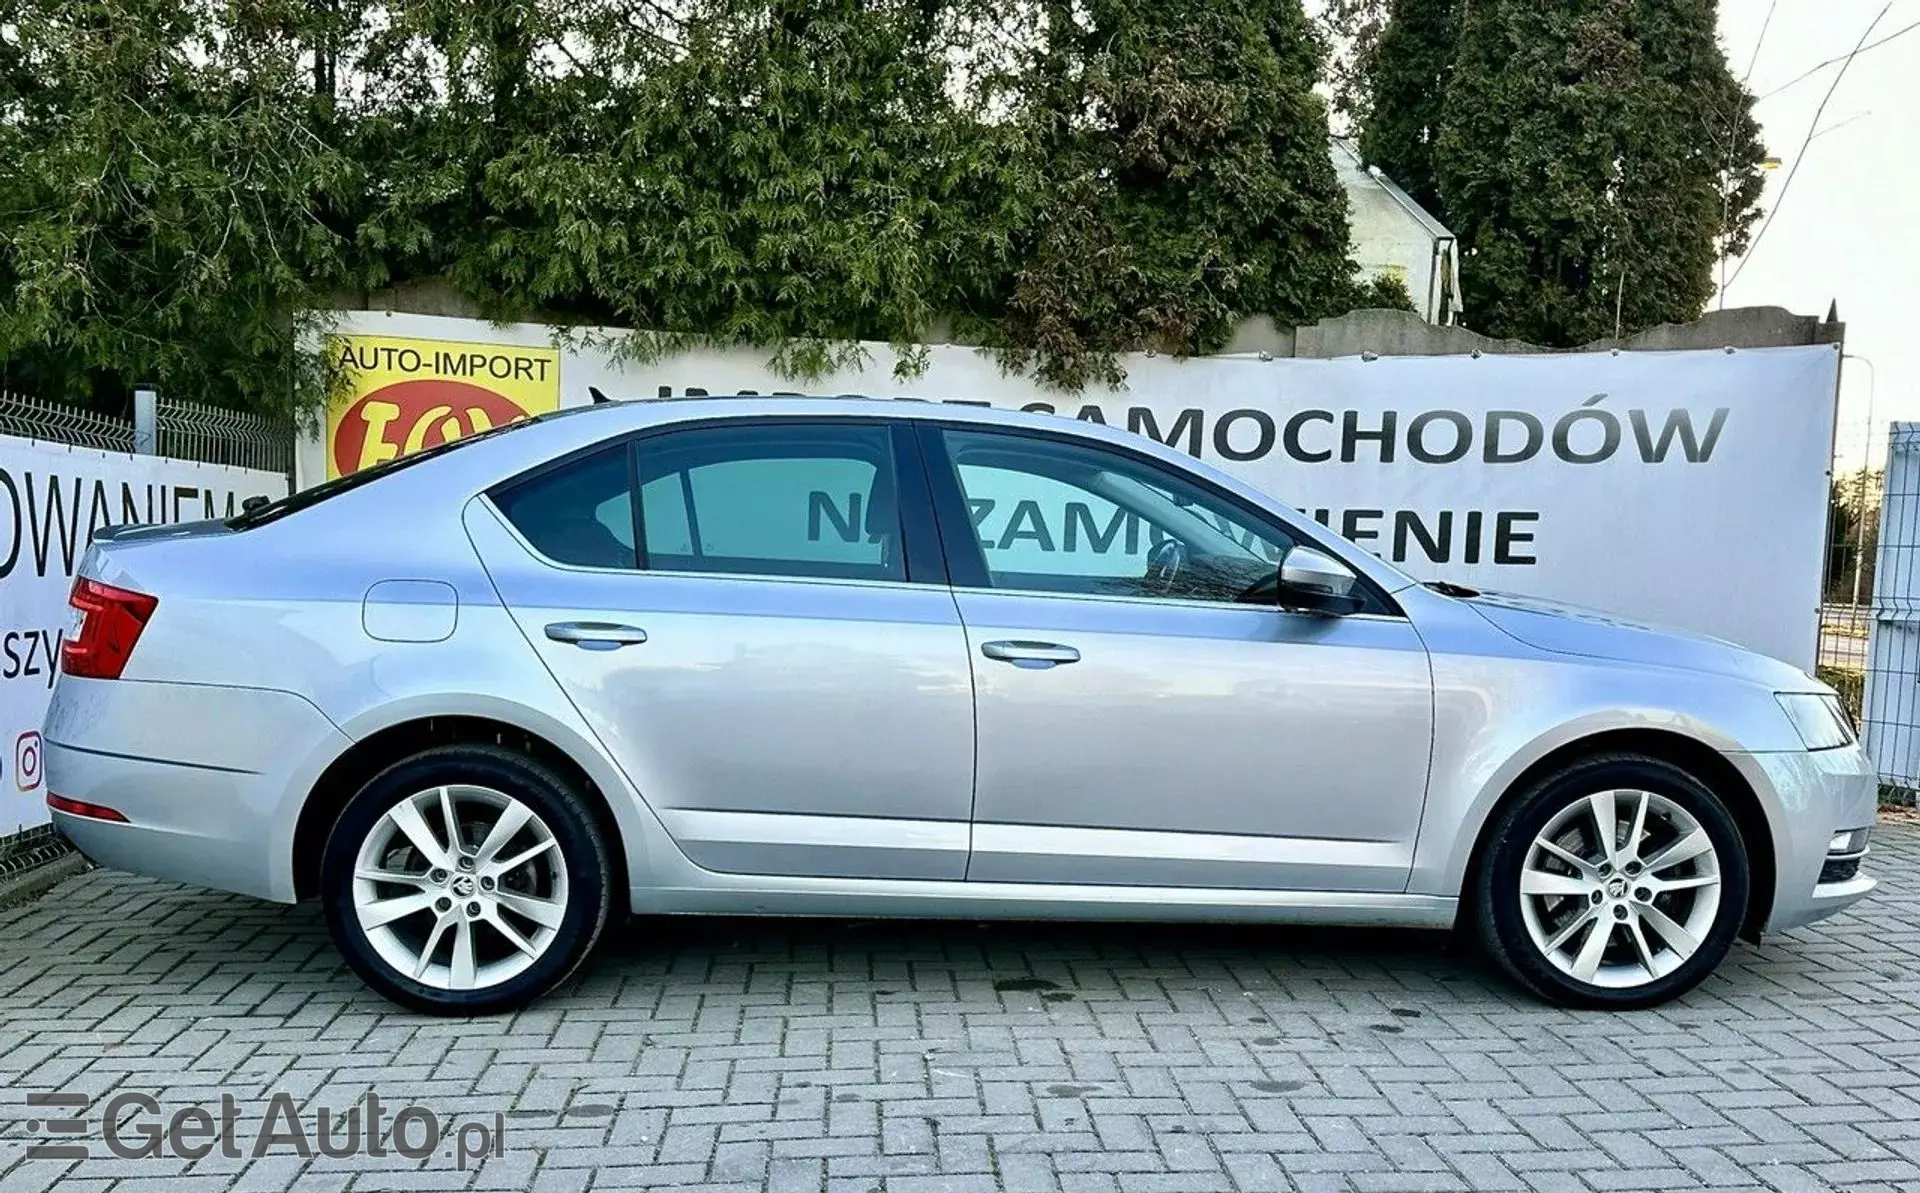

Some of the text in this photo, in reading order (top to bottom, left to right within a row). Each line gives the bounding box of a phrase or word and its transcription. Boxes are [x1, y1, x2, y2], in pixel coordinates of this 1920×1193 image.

[339, 345, 552, 382] AUTO-IMPORT
[1019, 394, 1730, 464] MOCHODÓW
[967, 497, 1540, 565] ZAMENIE
